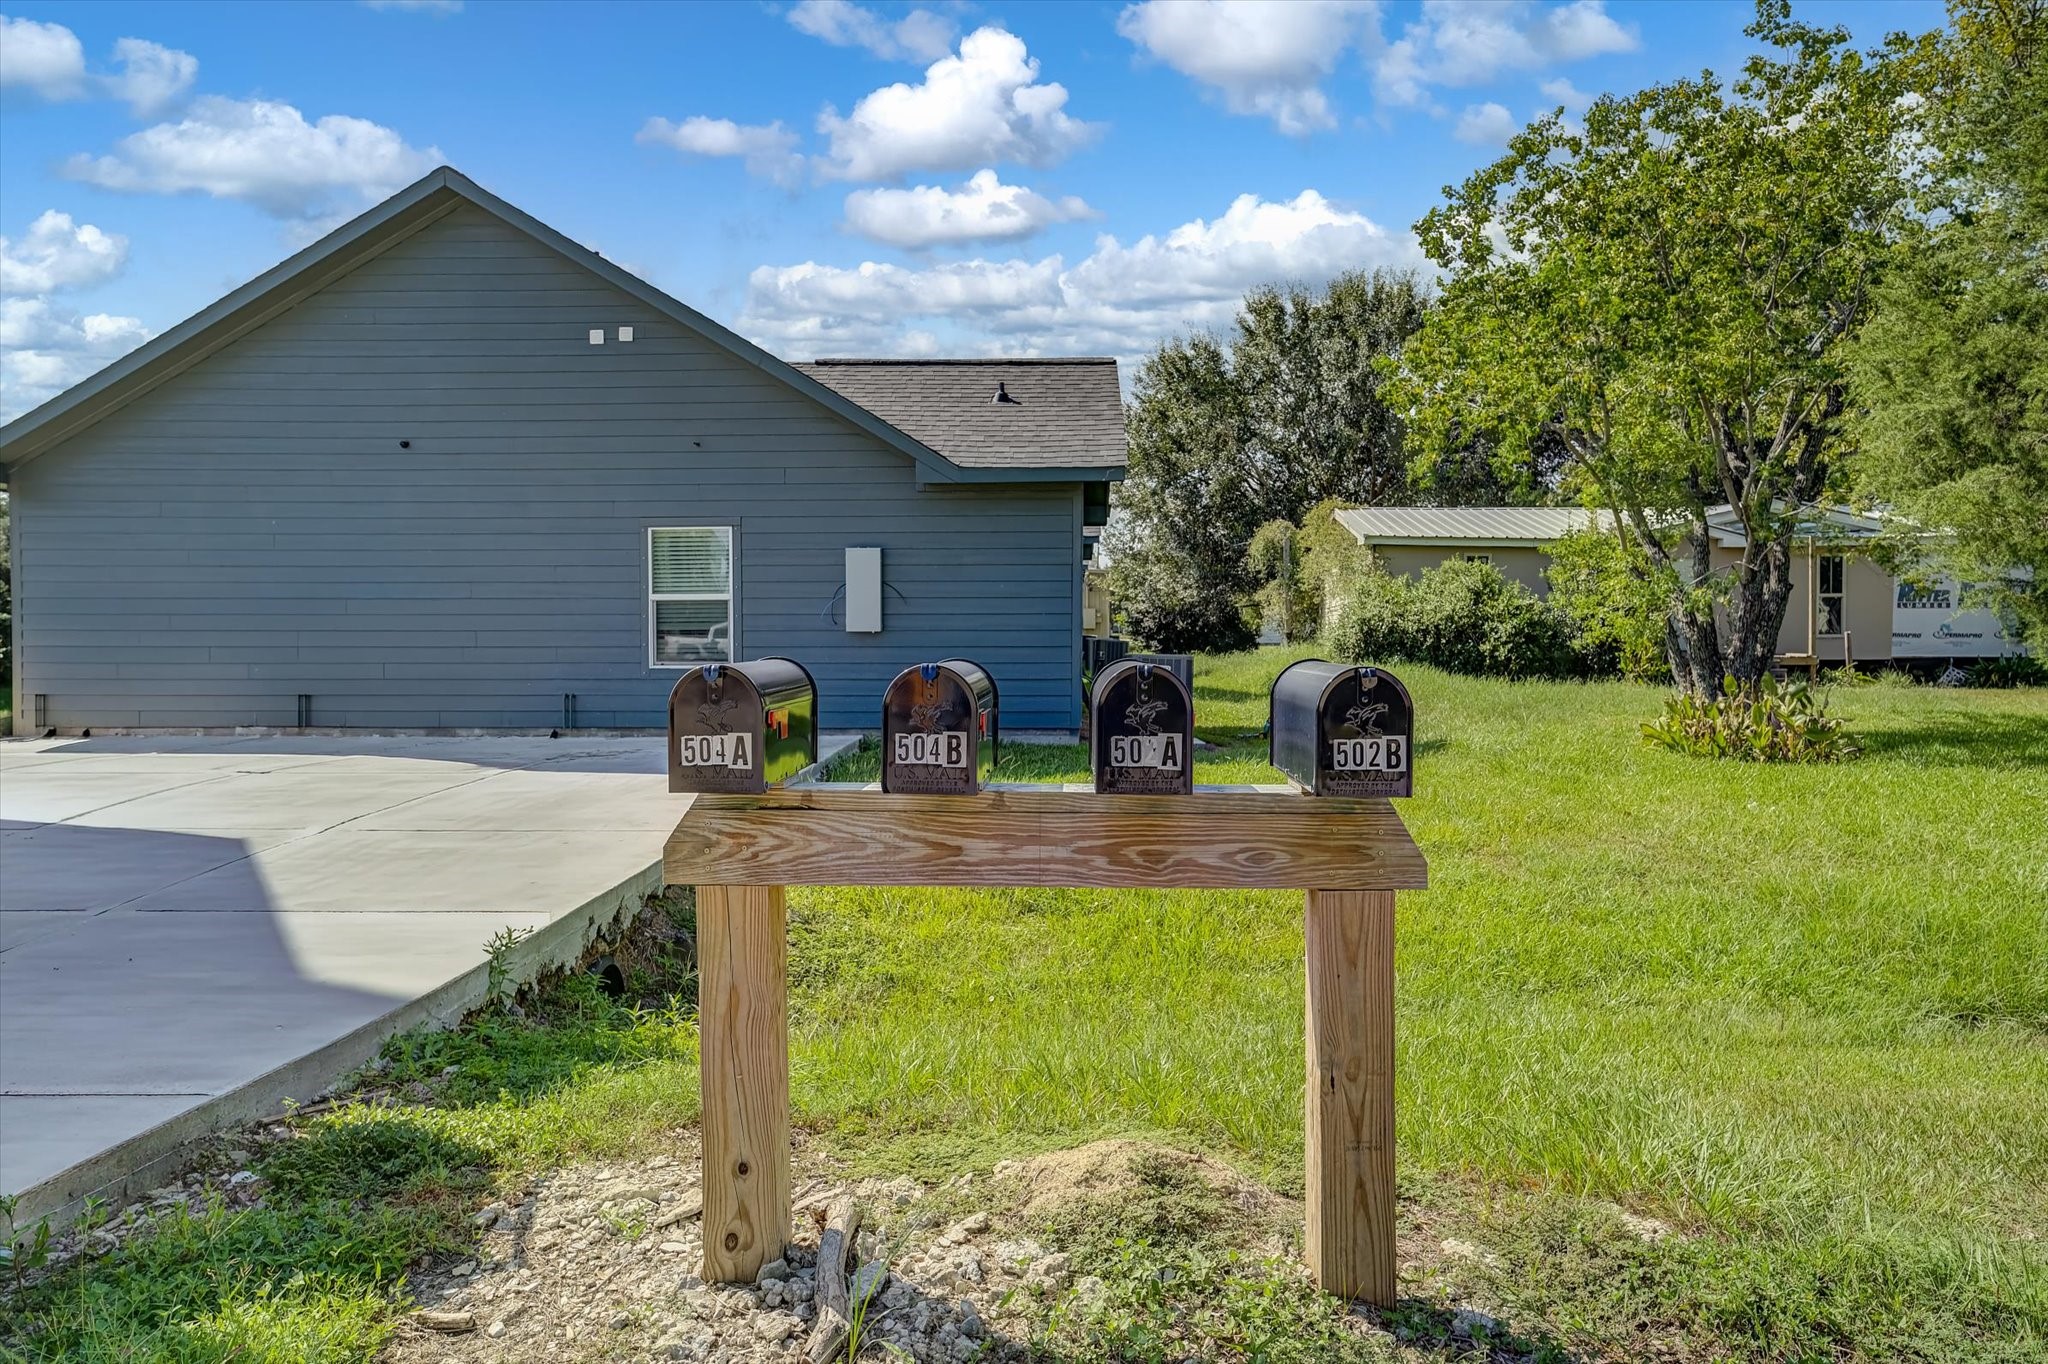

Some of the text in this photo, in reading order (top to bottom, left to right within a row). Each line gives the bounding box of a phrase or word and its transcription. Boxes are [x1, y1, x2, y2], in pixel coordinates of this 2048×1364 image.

[684, 735, 749, 766] 504A
[897, 734, 962, 765] 504B
[1336, 738, 1402, 770] 502B
